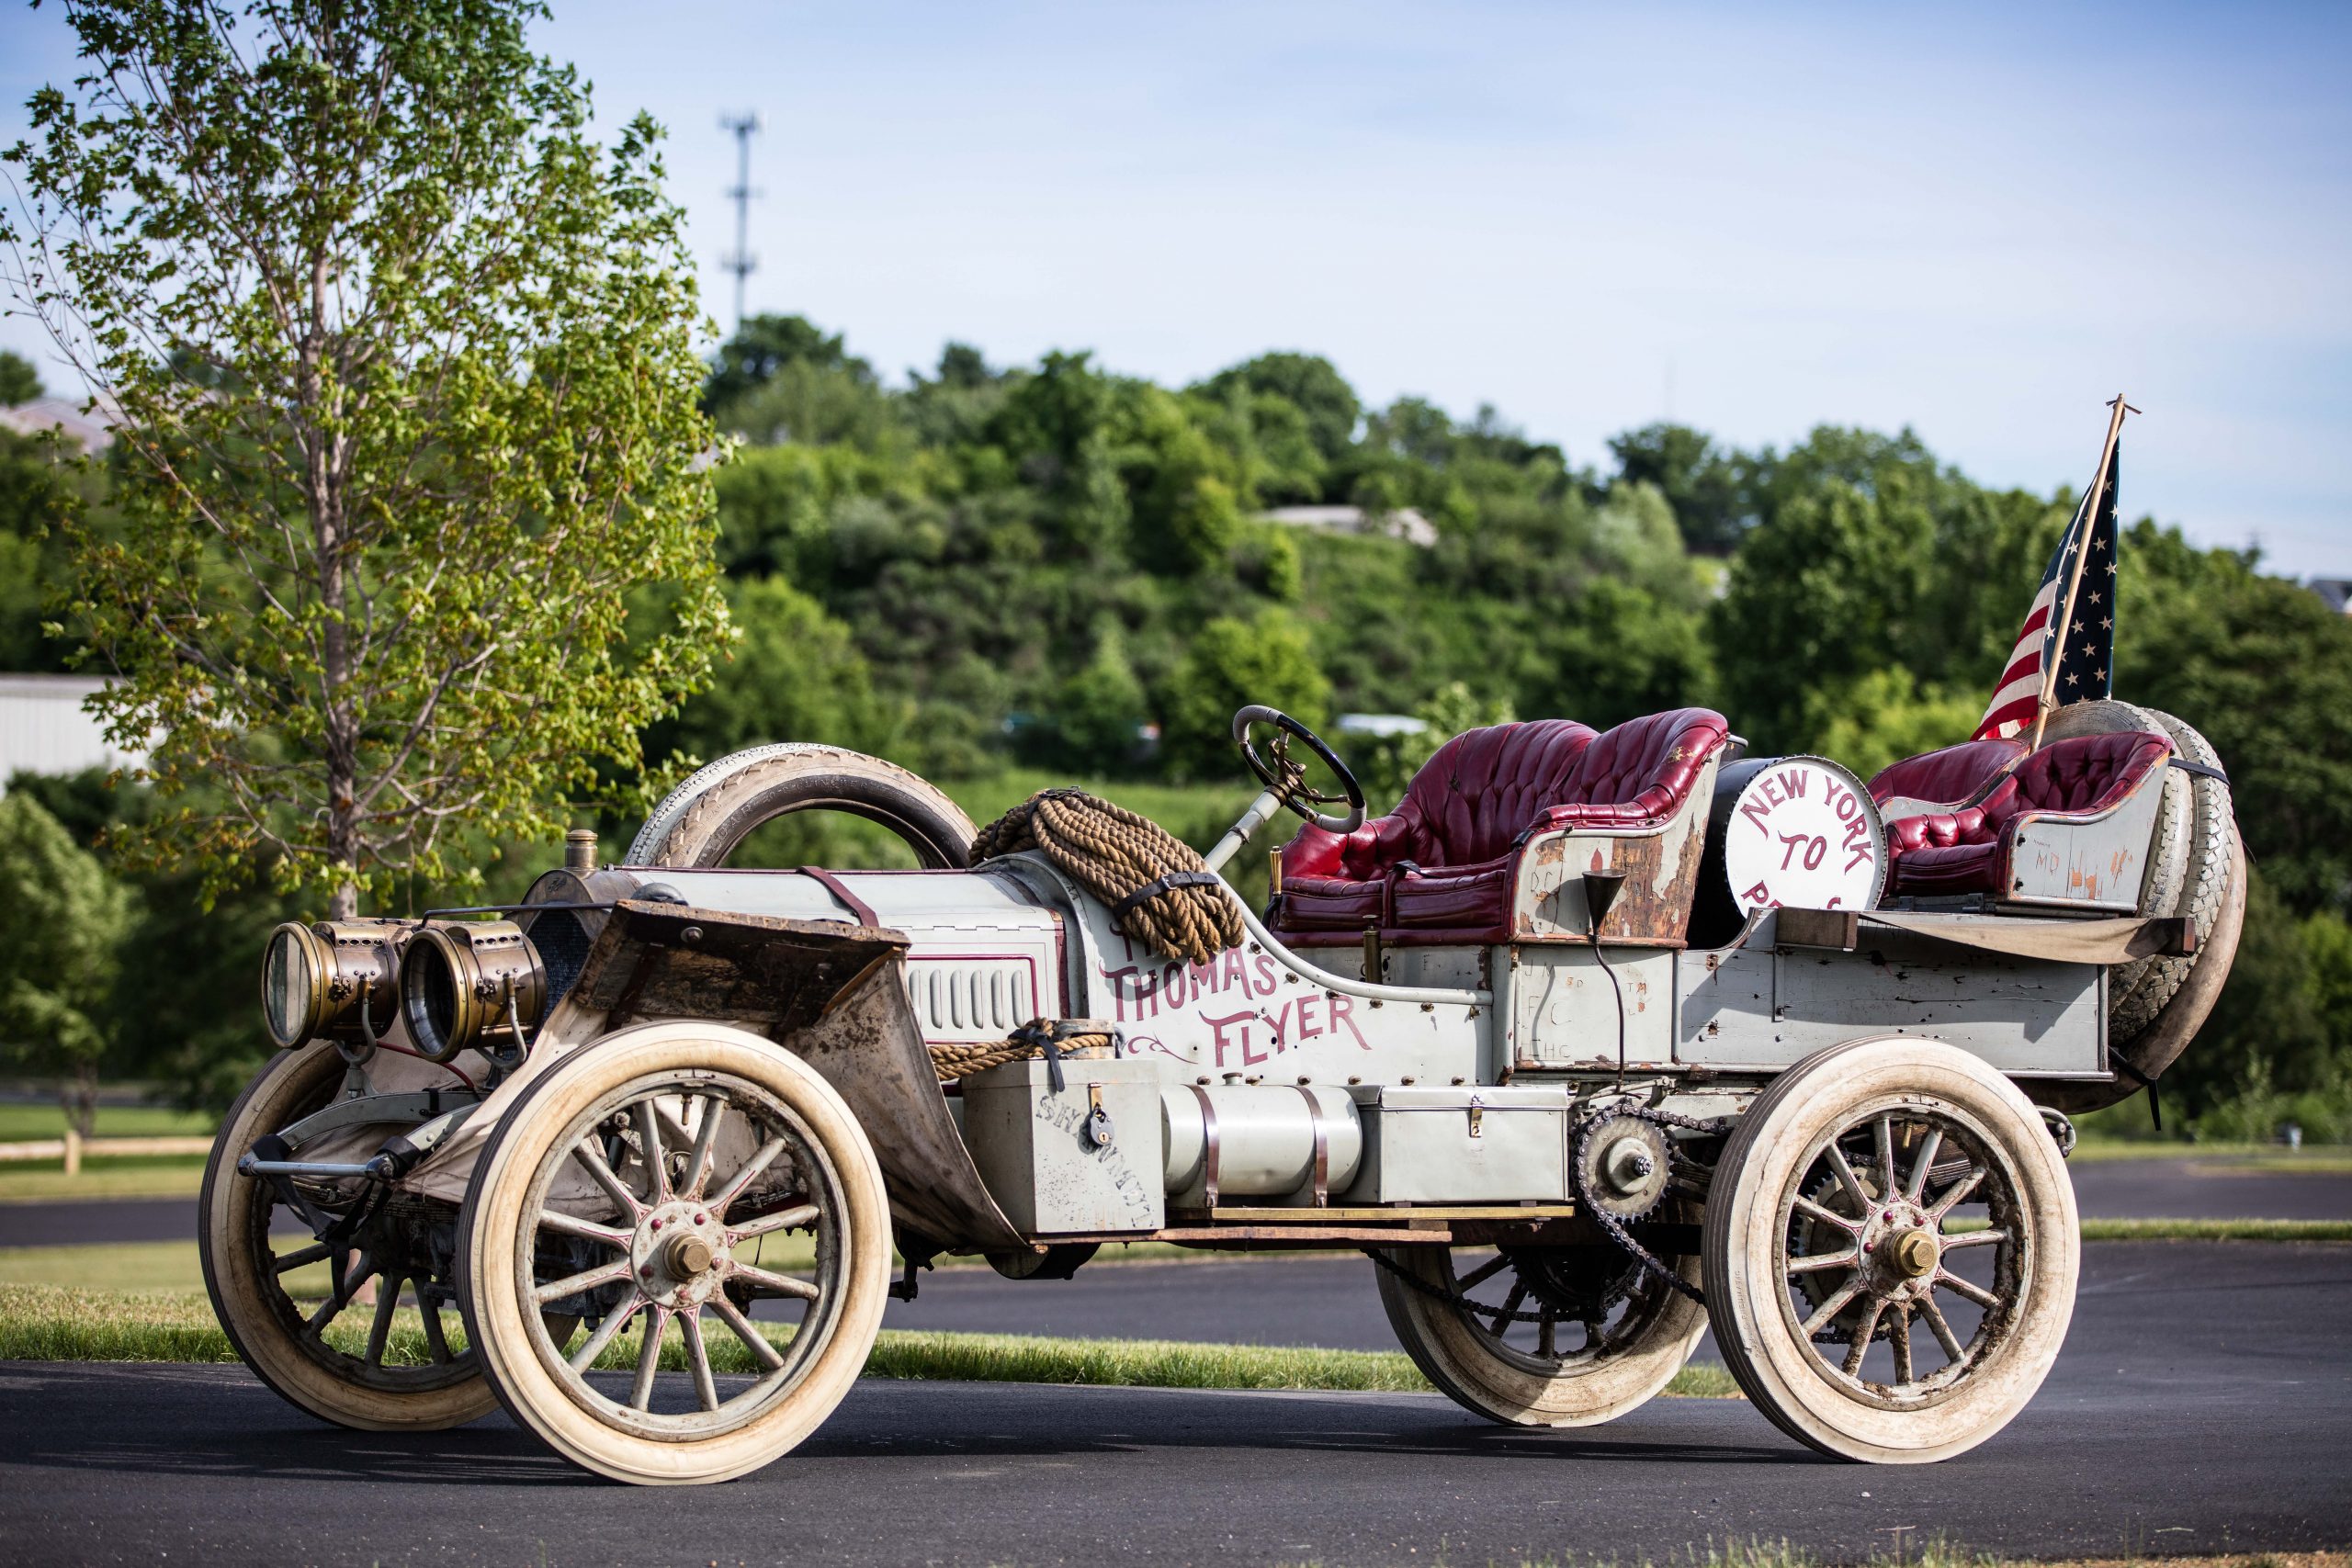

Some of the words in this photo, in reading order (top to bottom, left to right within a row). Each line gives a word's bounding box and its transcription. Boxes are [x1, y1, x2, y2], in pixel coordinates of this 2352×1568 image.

[1739, 769, 1809, 841] NEW
[1824, 774, 1874, 875] YORK
[1777, 829, 1827, 872] TO
[1098, 946, 1277, 1022] THOMAS
[1198, 994, 1373, 1067] FLYER
